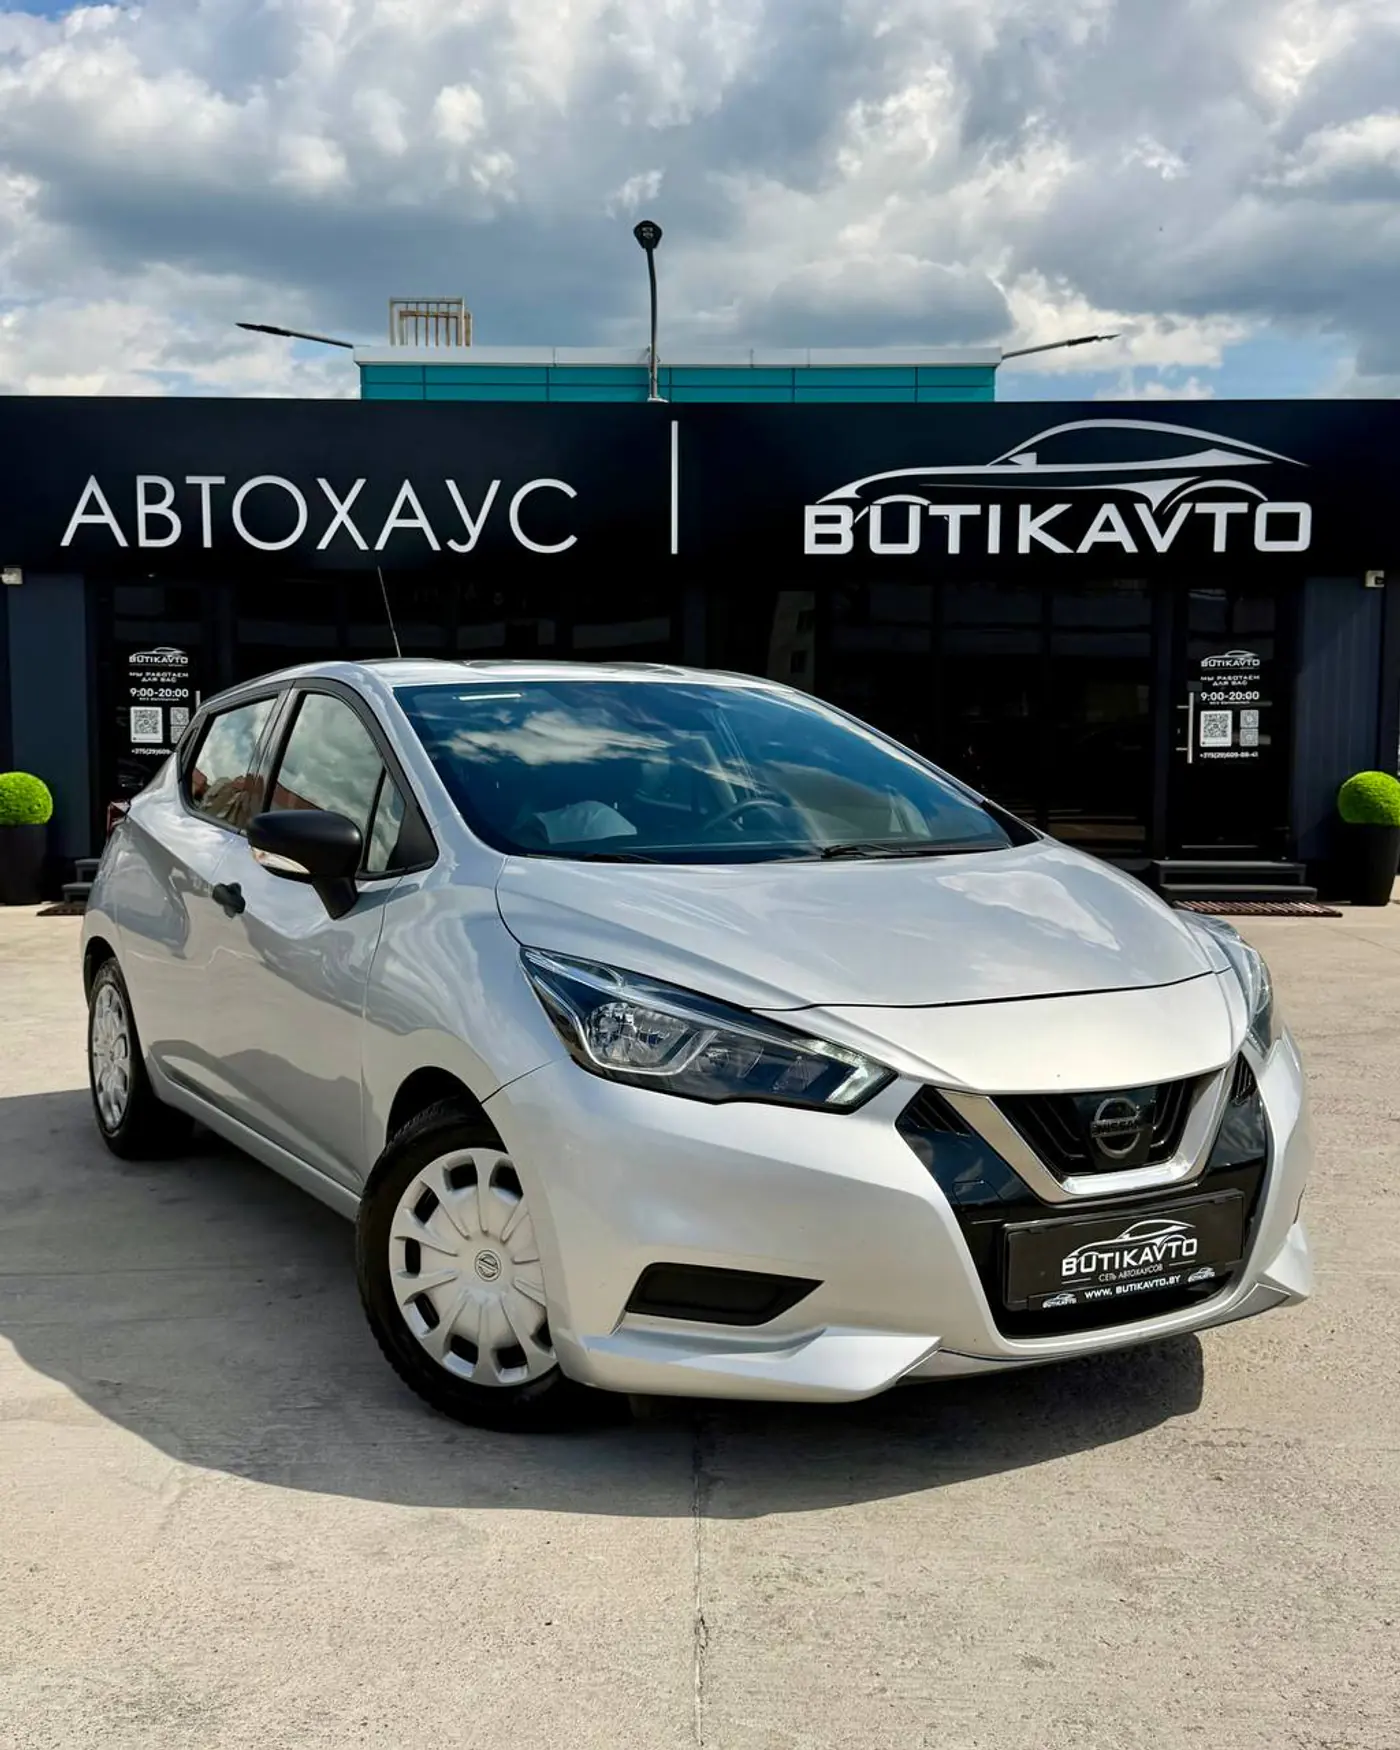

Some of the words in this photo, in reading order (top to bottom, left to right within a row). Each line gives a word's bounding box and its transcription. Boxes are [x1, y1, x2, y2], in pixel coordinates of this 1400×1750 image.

[60, 474, 578, 554] АВТОХАУС
[803, 501, 1312, 555] BUTIKAVTO
[128, 656, 189, 664] BUTIKAVTO
[1200, 659, 1261, 667] BUTIKAVTO
[129, 688, 189, 698] 9:00-20:00
[1200, 691, 1260, 701] 9:00-20:00
[1061, 1237, 1198, 1277] BUTIKAVTO
[1098, 1272, 1117, 1283] СЕТЬ
[1118, 1264, 1164, 1280] АВТОХАУСОВ
[1085, 1288, 1113, 1300] WWW.
[1115, 1275, 1181, 1294] BUTIKAVTO.BY
